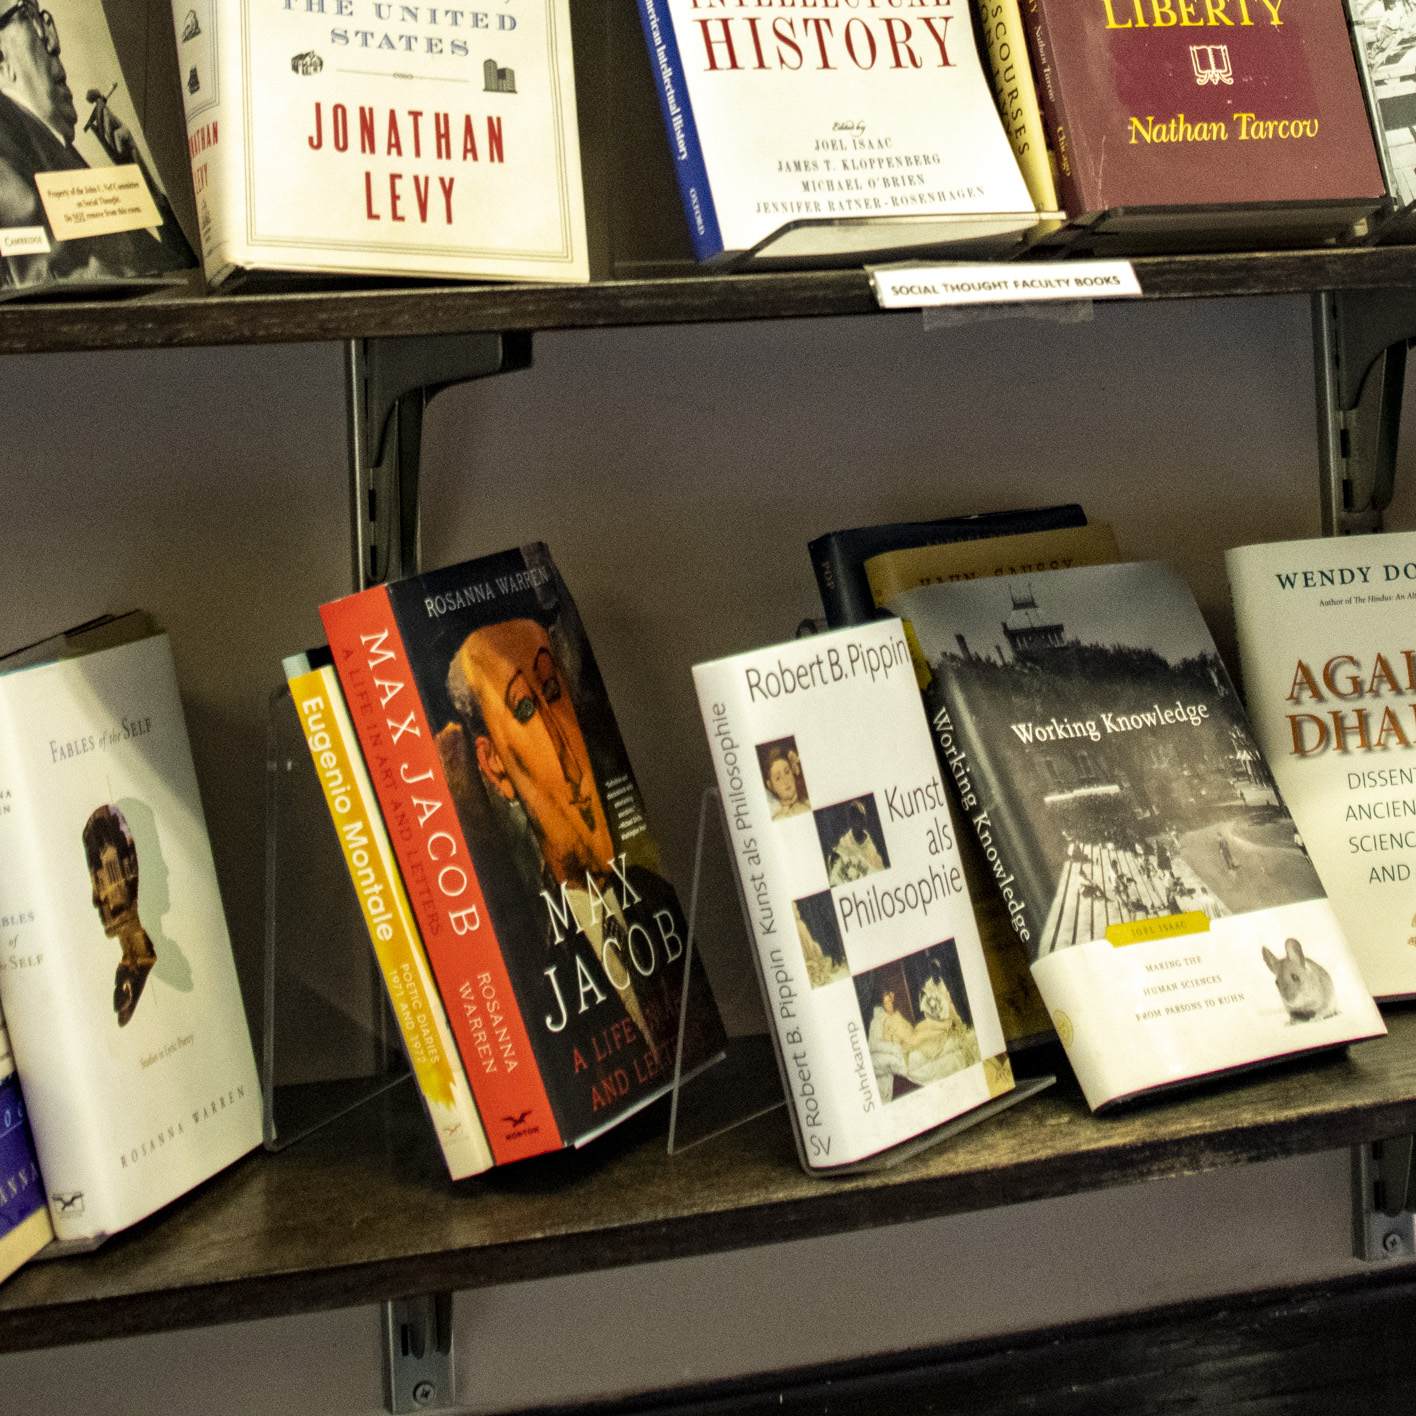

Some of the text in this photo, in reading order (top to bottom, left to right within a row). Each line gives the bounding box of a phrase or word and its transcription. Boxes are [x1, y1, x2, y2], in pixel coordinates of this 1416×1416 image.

[692, 16, 958, 73] HISTORY
[308, 102, 505, 164] JONATHAN
[1129, 111, 1319, 145] Nathan Tarcov
[365, 170, 455, 226] LEVY
[891, 274, 1121, 297] SOCIAL THOUGHT FACULTY BOOKS
[1275, 566, 1372, 591] WENDY
[745, 635, 911, 704] Robert B. Pippin
[1010, 700, 1210, 747] Working Knowledge
[360, 627, 482, 937] MAX JACOB
[884, 776, 946, 825] Kunst
[302, 694, 395, 944] Eugenio Montale
[927, 822, 955, 859] als
[539, 852, 643, 946] MAX
[838, 864, 964, 934] Philosophie
[543, 908, 685, 1034] JACOB
